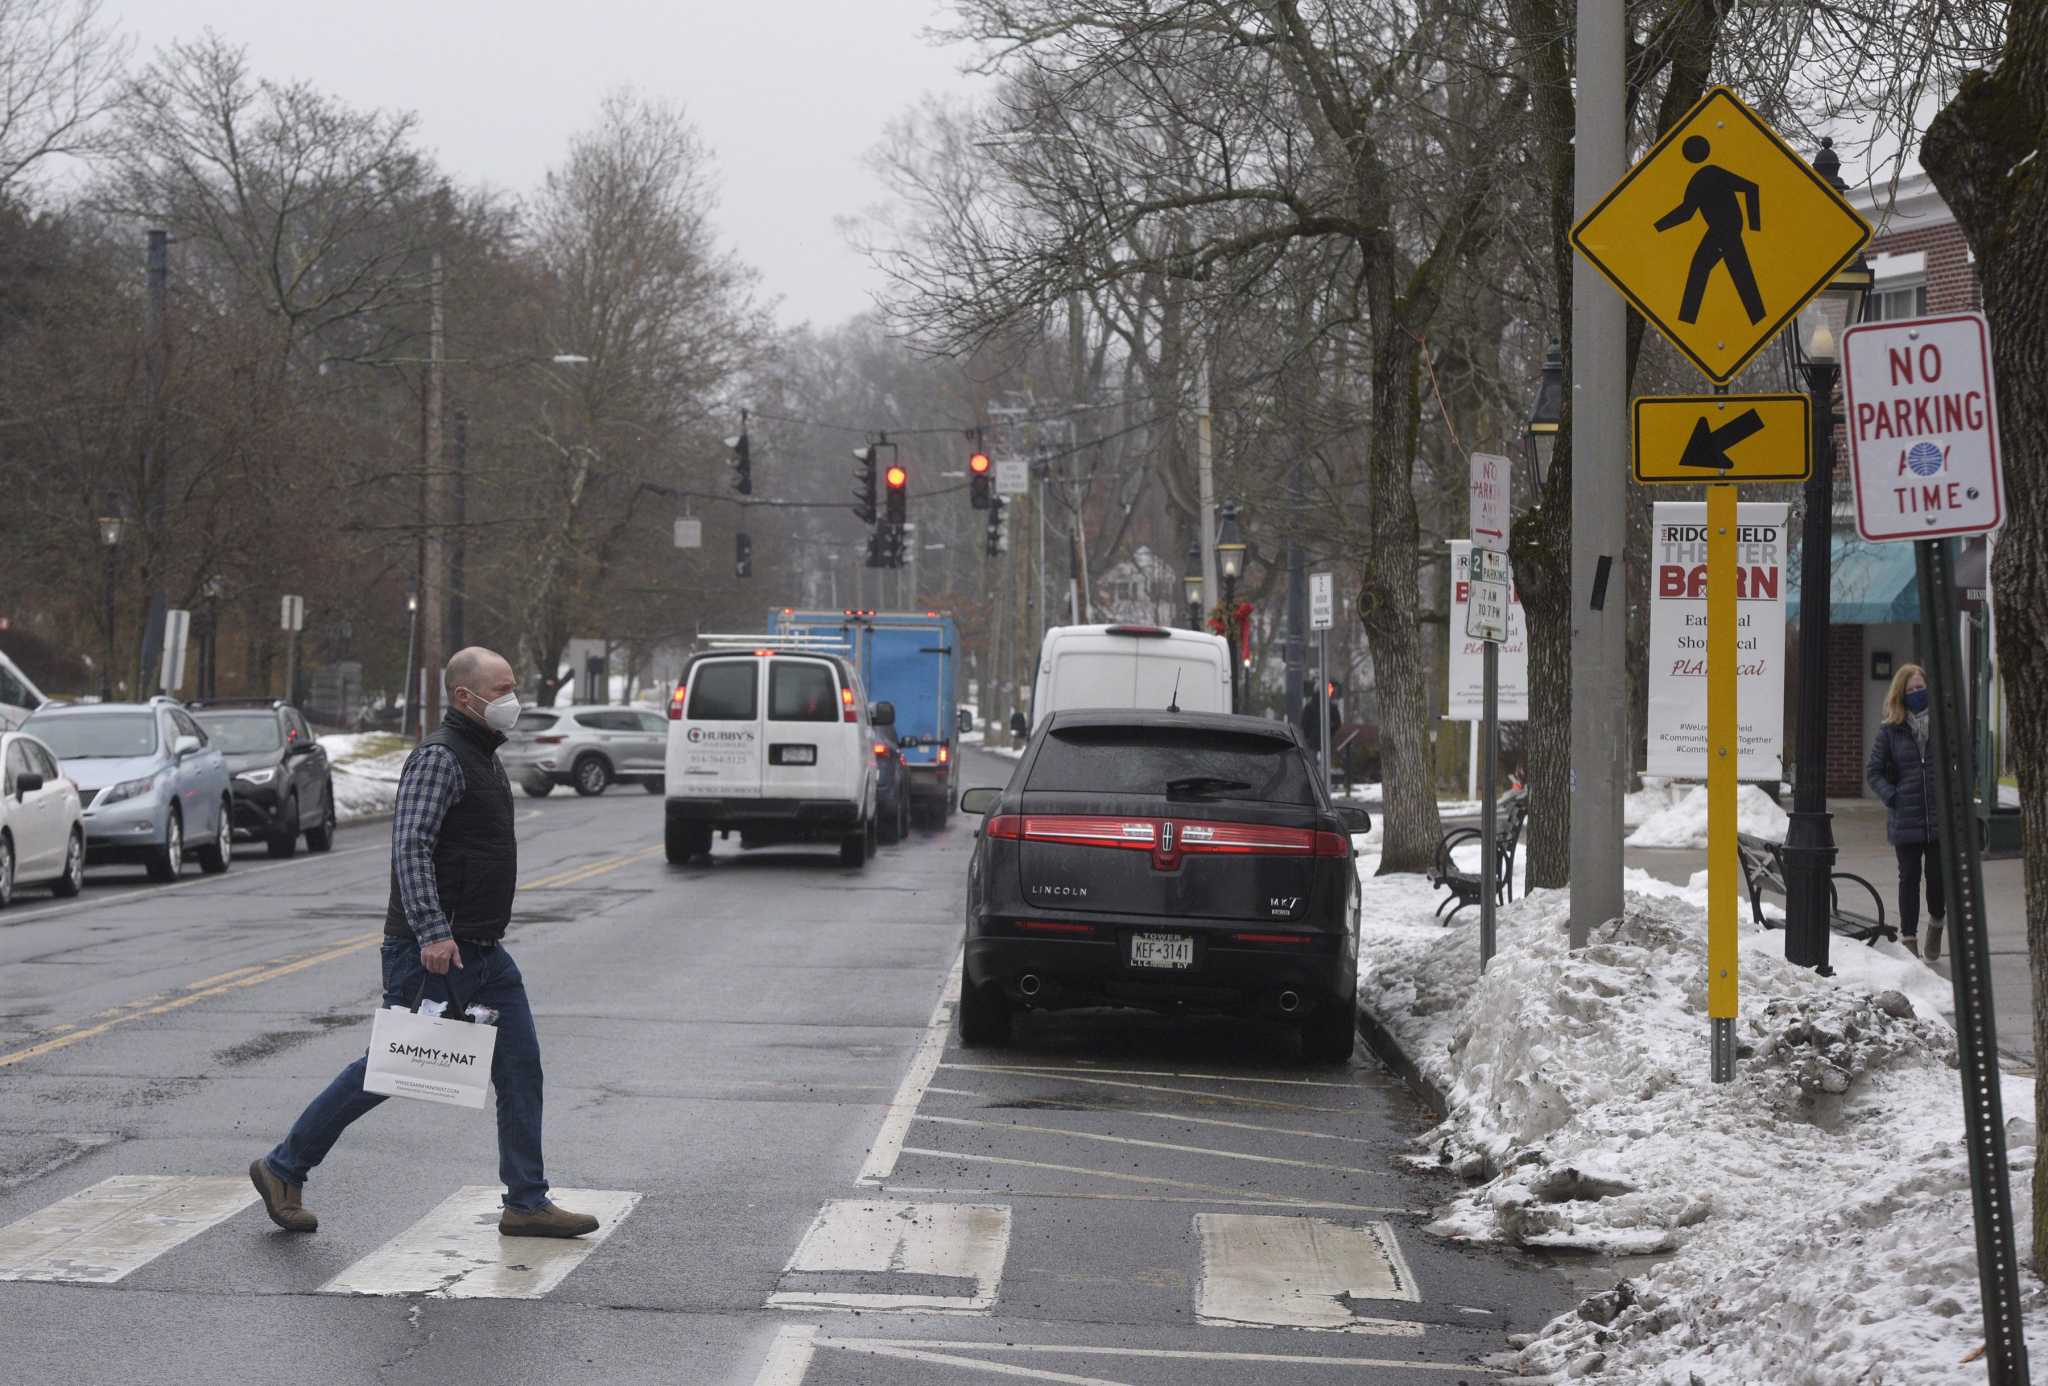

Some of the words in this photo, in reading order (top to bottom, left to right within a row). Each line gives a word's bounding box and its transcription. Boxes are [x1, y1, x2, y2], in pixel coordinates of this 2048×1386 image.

[1889, 343, 1942, 387] NO
[1857, 391, 1984, 441] PARKING
[1483, 463, 1497, 480] NO
[1472, 481, 1501, 500] PARK
[1893, 482, 1963, 514] TIME
[1474, 555, 1481, 572] 2
[1481, 589, 1487, 601] 7
[1488, 591, 1497, 602] AM
[1492, 606, 1501, 618] PM
[1032, 884, 1087, 897] LINCOLN
